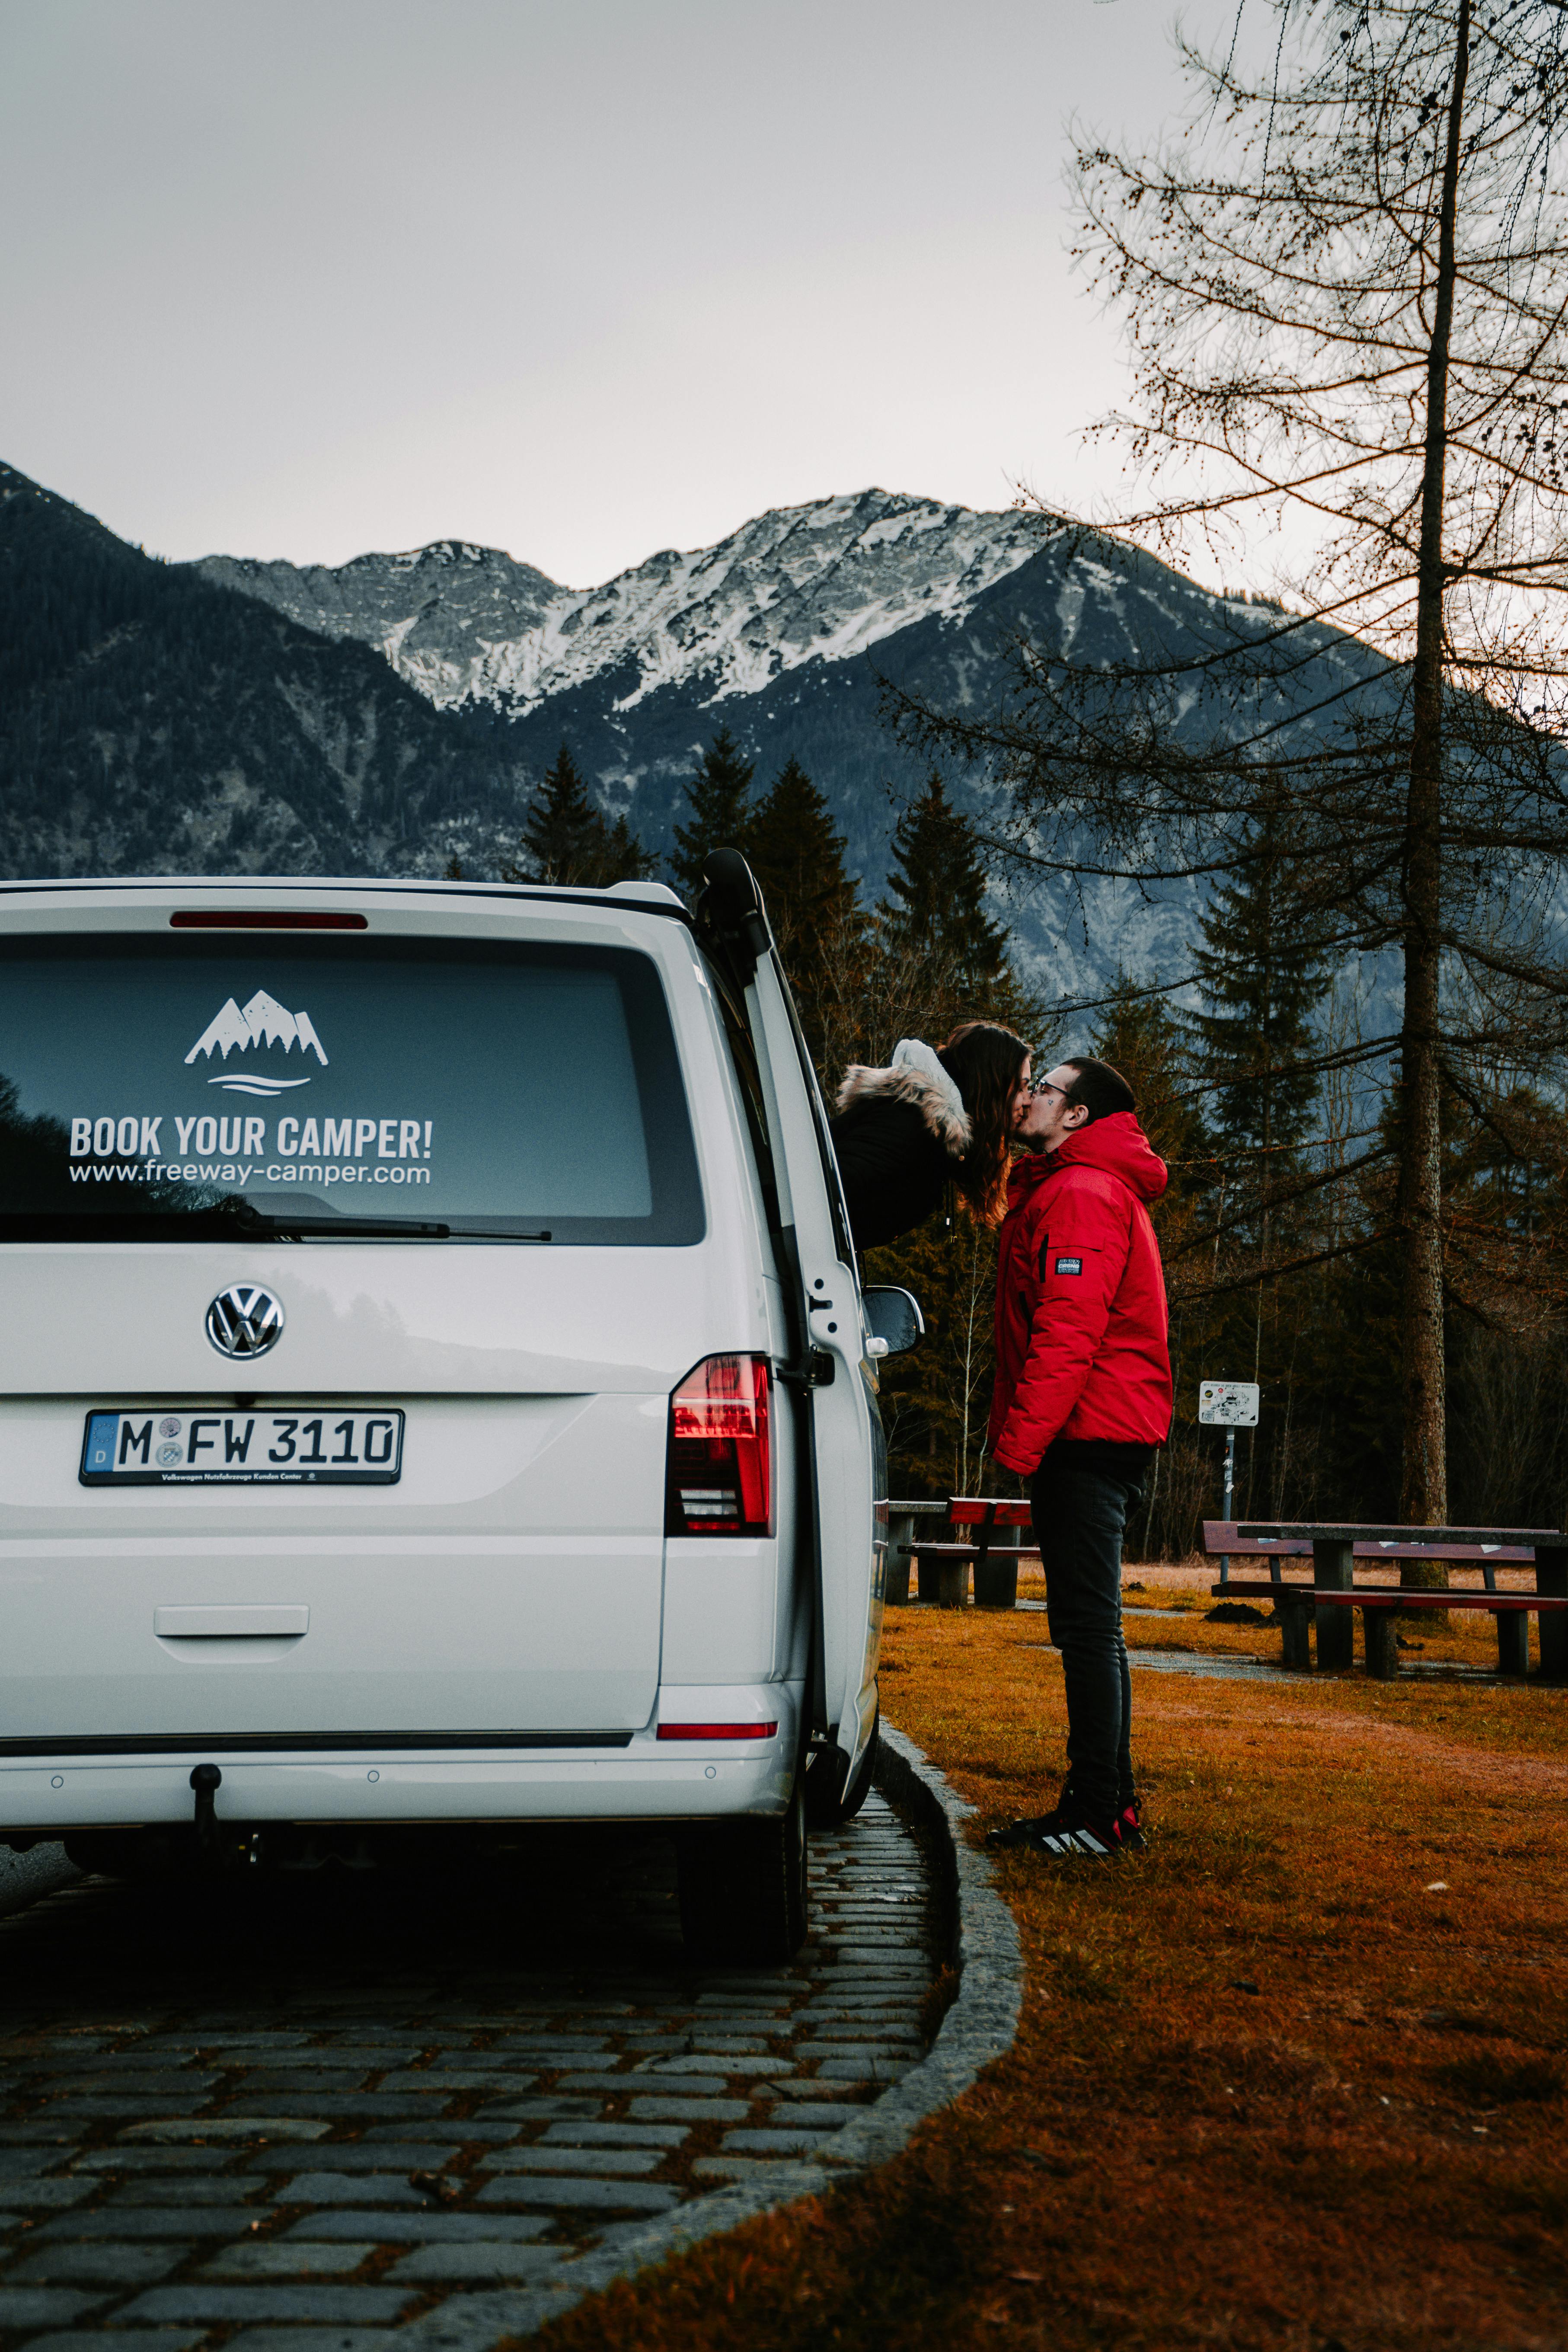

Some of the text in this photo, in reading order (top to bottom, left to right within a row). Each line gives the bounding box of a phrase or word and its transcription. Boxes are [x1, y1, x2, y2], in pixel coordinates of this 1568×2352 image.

[70, 1116, 433, 1159] BOOK YOUR CAMPER!
[69, 1159, 431, 1187] www.freeway-camper.com
[95, 1450, 106, 1464] D
[118, 1420, 153, 1464] M
[187, 1419, 255, 1464] FW
[268, 1419, 393, 1464] 3110
